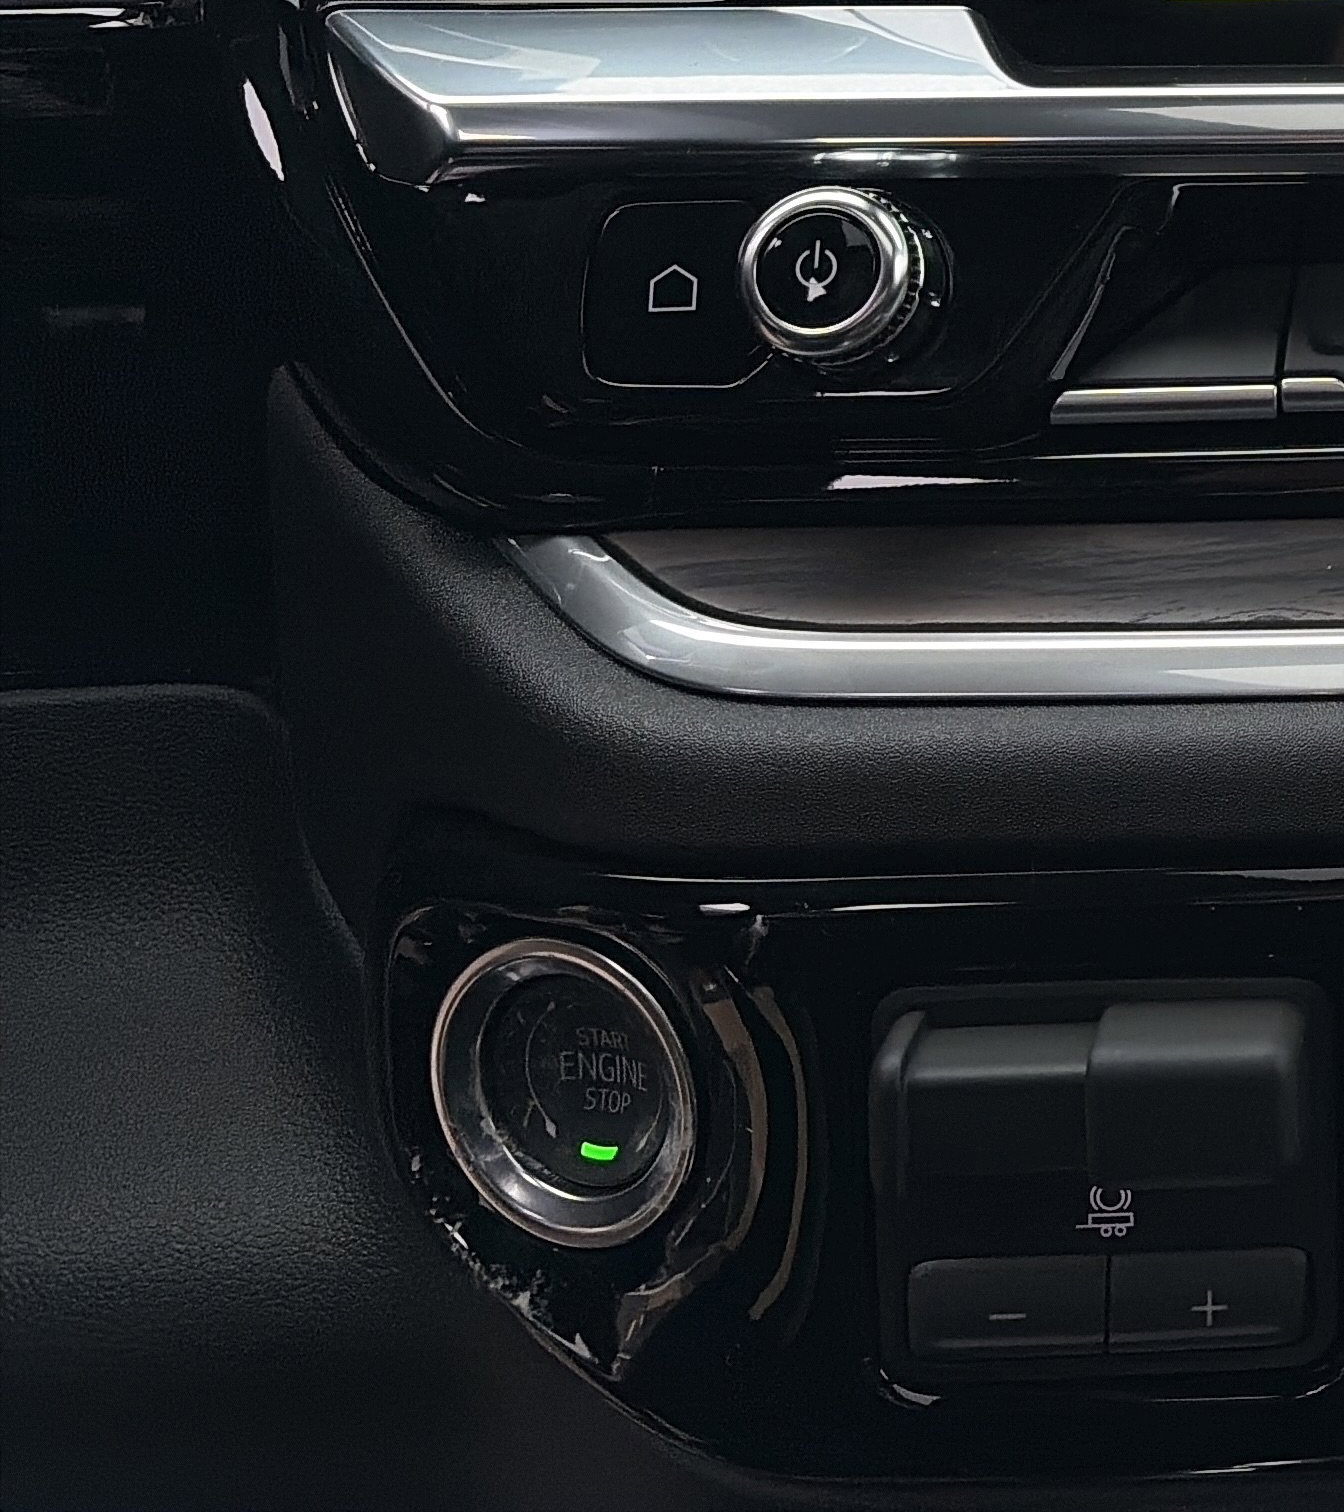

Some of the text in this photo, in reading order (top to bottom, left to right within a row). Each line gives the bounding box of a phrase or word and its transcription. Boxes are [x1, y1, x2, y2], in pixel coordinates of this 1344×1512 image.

[576, 1027, 629, 1051] START
[560, 1049, 647, 1092] ENGINE
[583, 1087, 632, 1114] STOP
